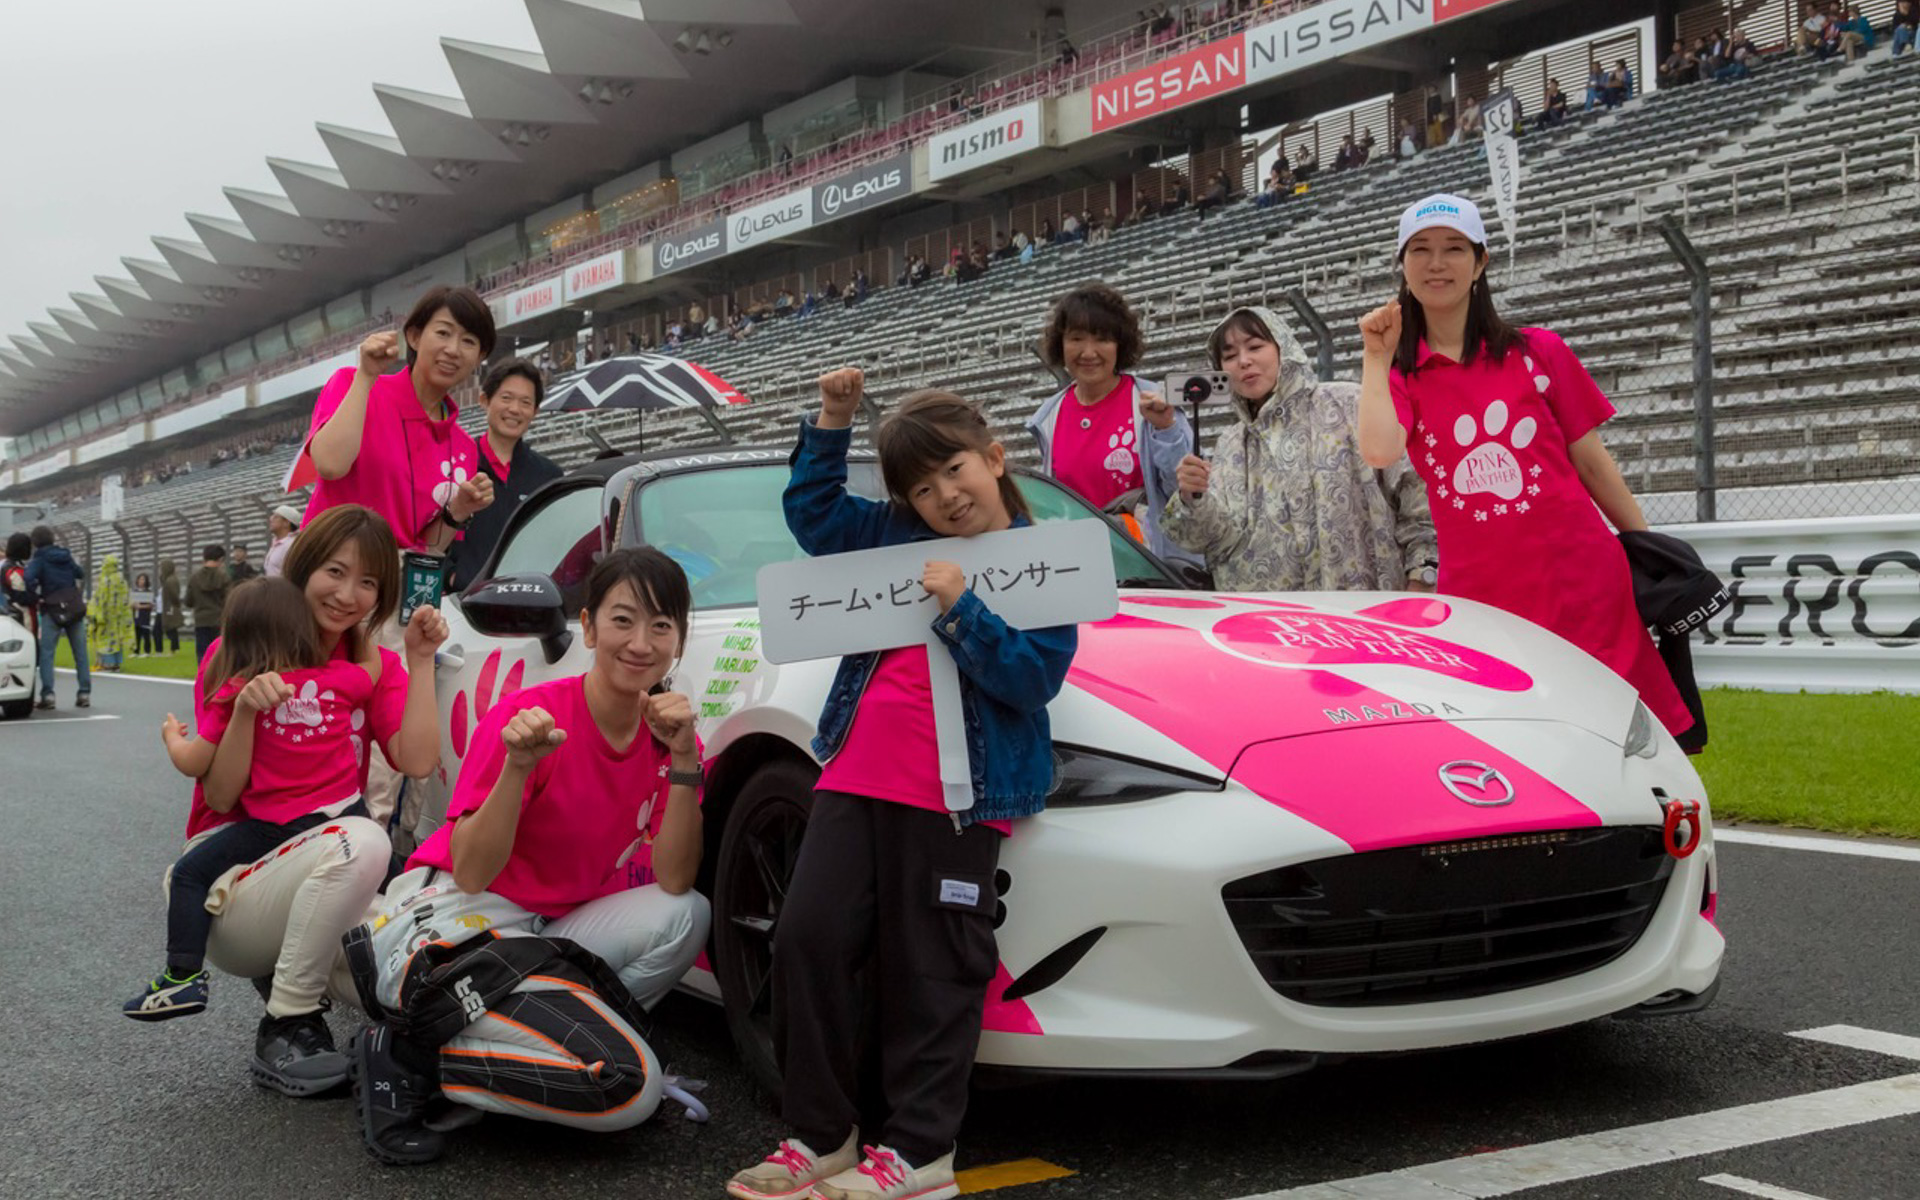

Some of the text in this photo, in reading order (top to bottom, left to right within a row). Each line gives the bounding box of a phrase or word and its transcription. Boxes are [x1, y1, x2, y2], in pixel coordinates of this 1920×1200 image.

[1097, 47, 1241, 121] NISSAN
[842, 169, 901, 203] LEXUS
[752, 203, 804, 233] LEXUS
[674, 232, 720, 259] LEXUS
[581, 260, 616, 287] YAMAHA
[521, 287, 553, 313] YAMAHA
[674, 449, 792, 467] MAZDA
[1466, 452, 1512, 478] PINK
[1465, 468, 1518, 493] PANTHER
[497, 583, 545, 594] KTEL
[1700, 551, 1920, 647] ERO
[1265, 615, 1444, 651] PINK
[1267, 631, 1479, 672] PANTHER
[1325, 701, 1463, 725] MAZDA
